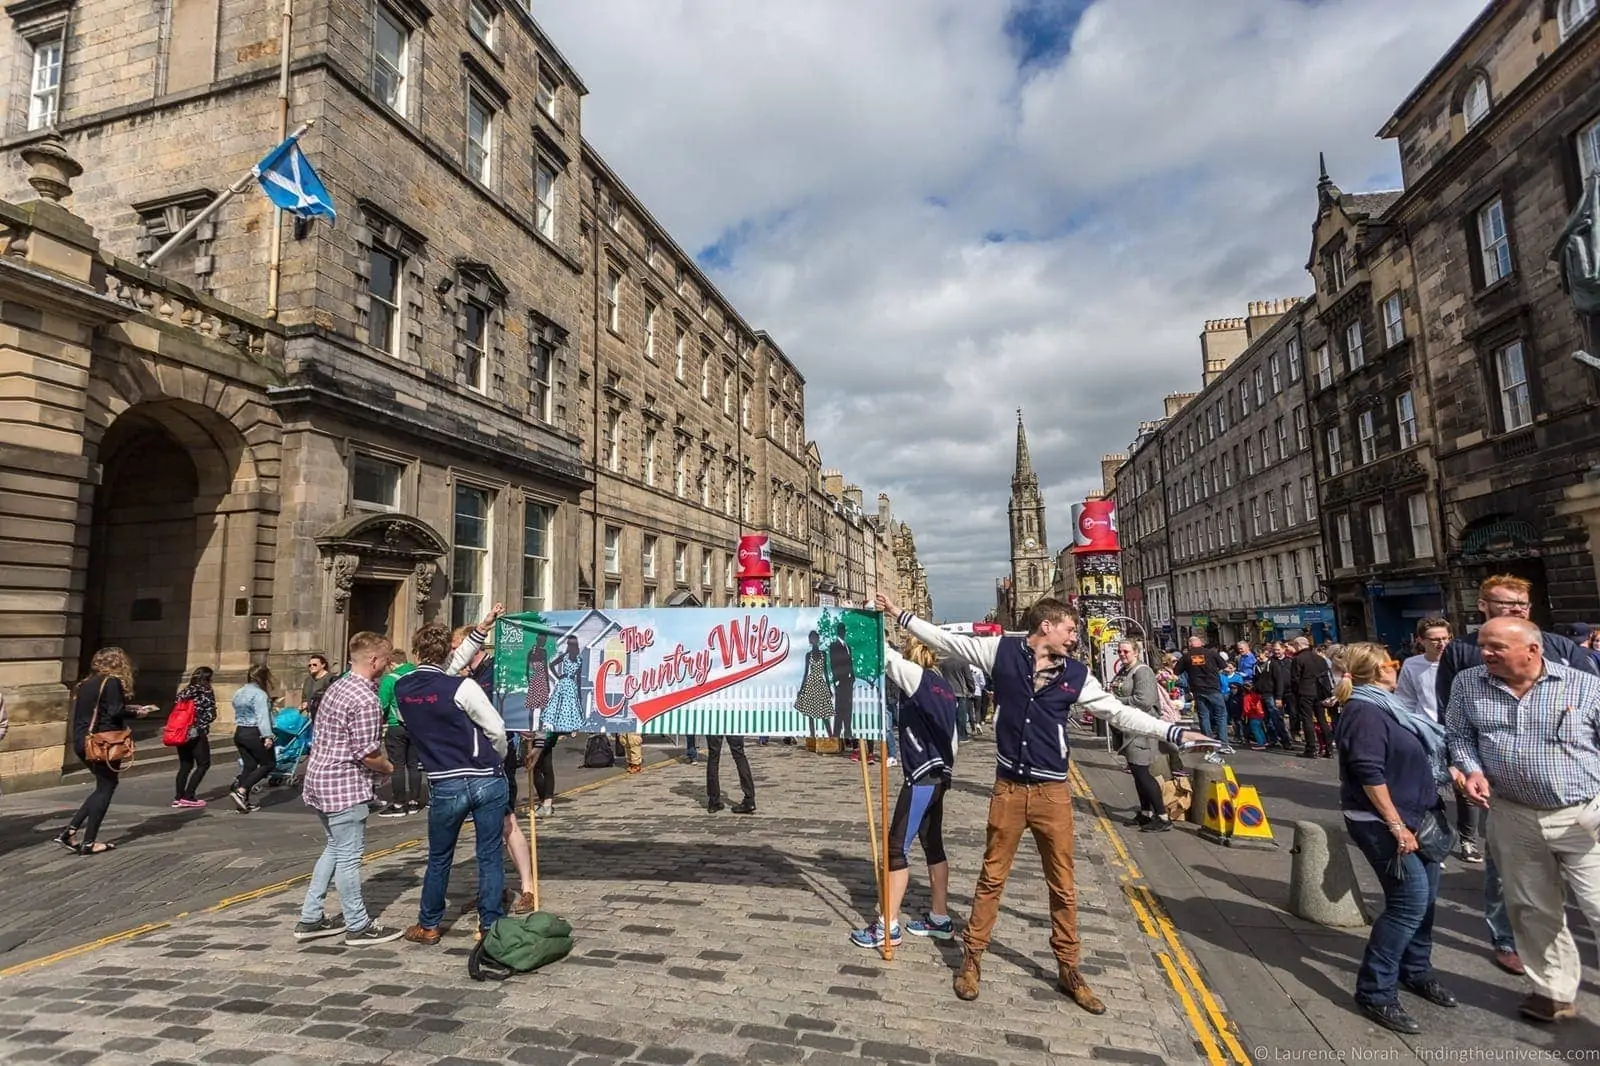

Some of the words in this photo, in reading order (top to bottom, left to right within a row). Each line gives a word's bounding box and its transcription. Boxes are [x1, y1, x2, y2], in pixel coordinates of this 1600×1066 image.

[594, 643, 714, 717] Country
[708, 613, 784, 669] Wife
[620, 625, 655, 654] The
